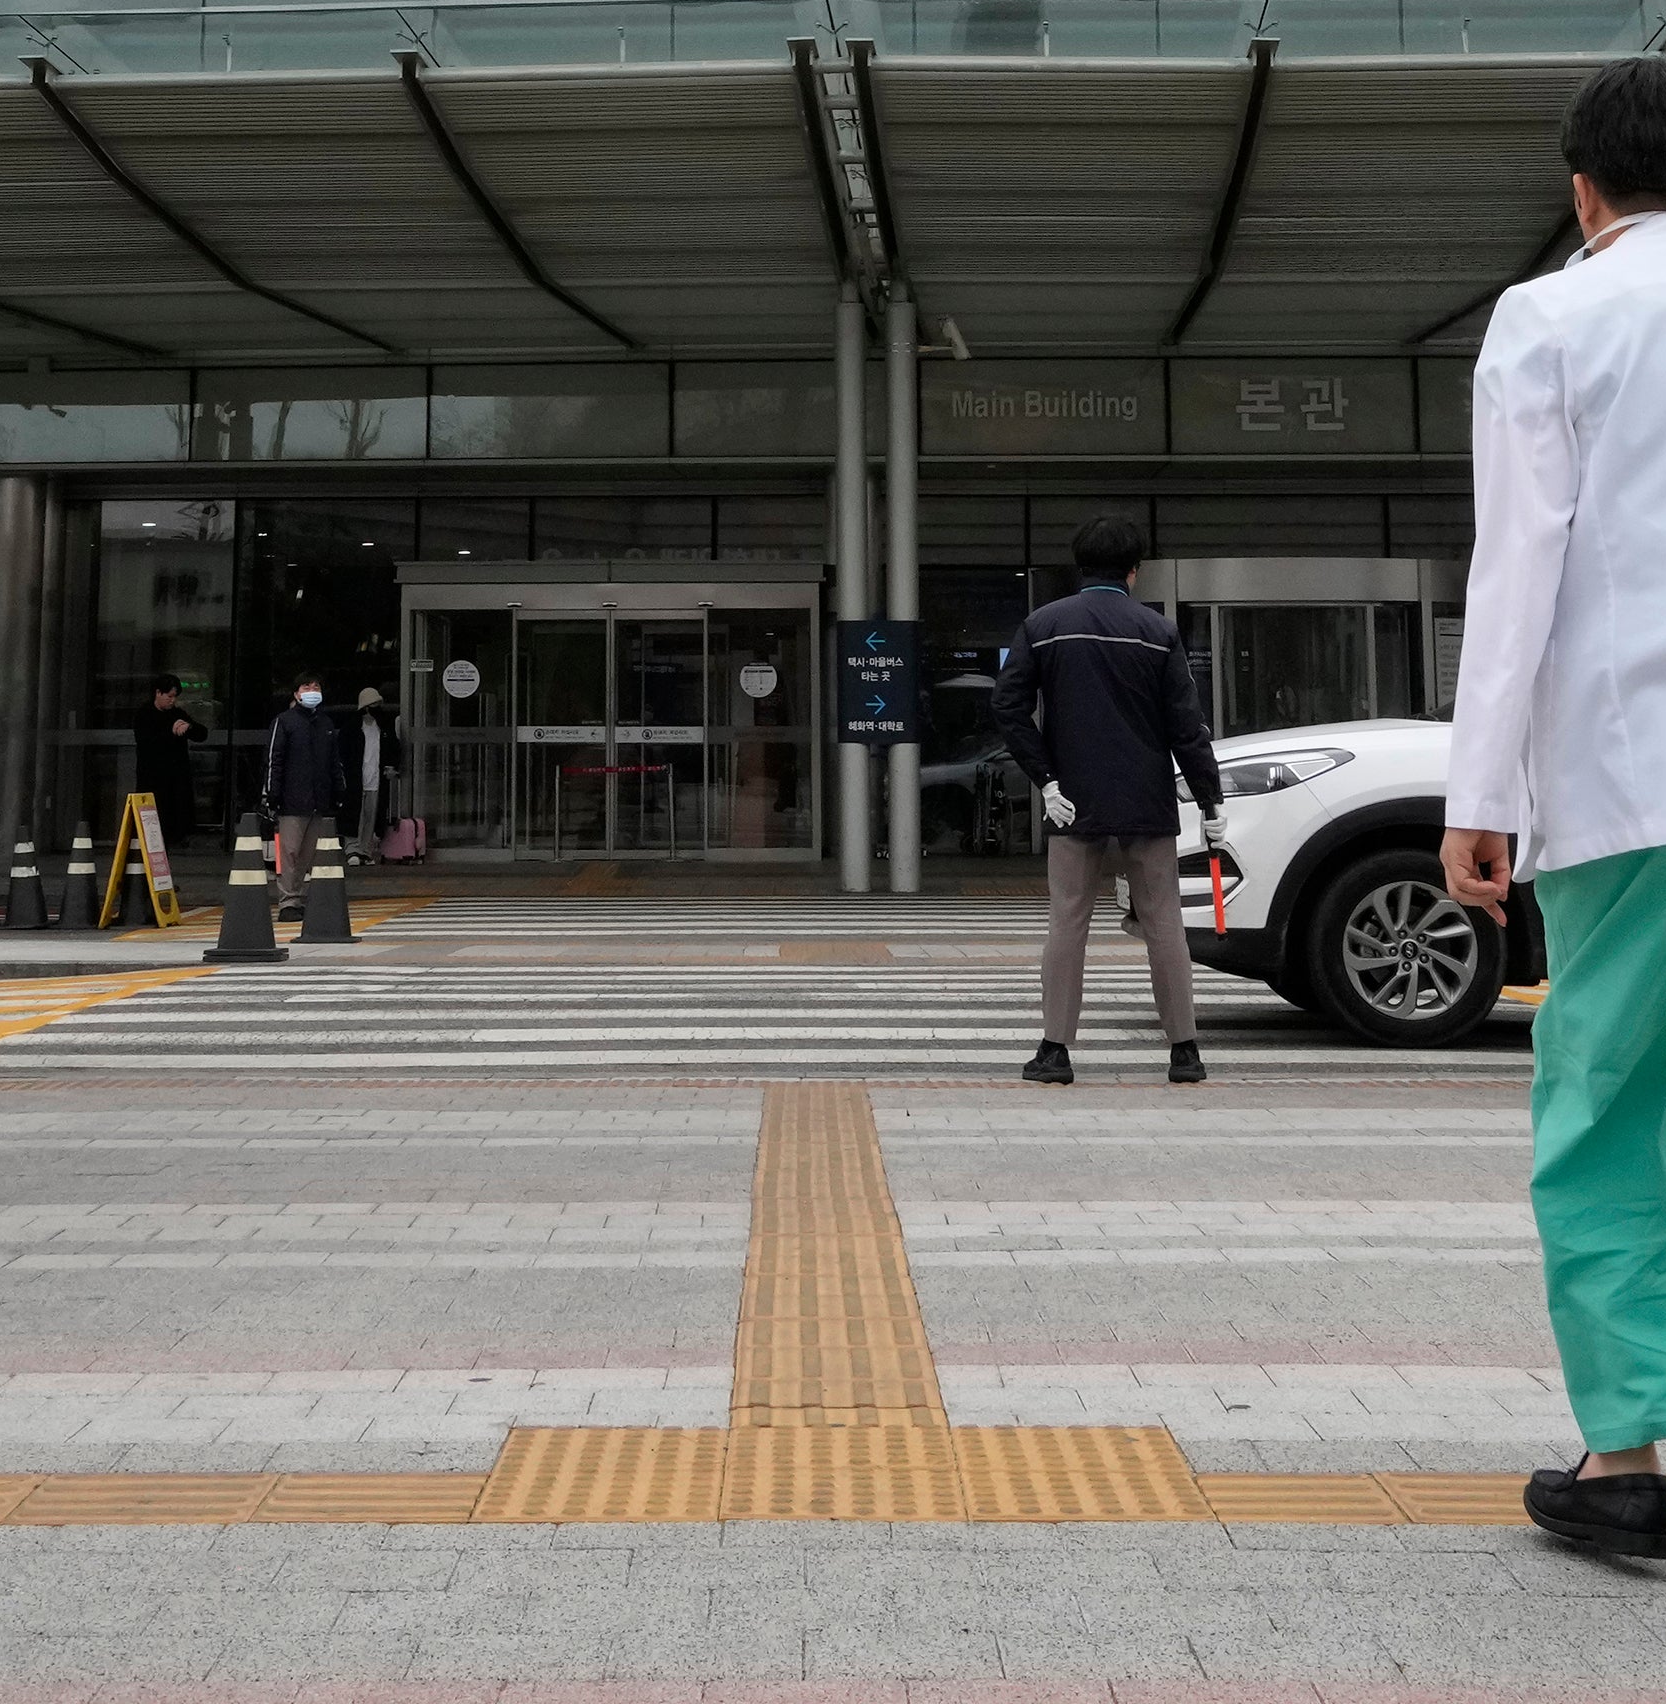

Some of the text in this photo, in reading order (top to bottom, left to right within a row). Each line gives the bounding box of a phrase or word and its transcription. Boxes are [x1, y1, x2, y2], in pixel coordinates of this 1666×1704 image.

[951, 389, 1139, 423] Main Building
[1235, 377, 1350, 432] 본관
[861, 671, 890, 682] 타는 곳
